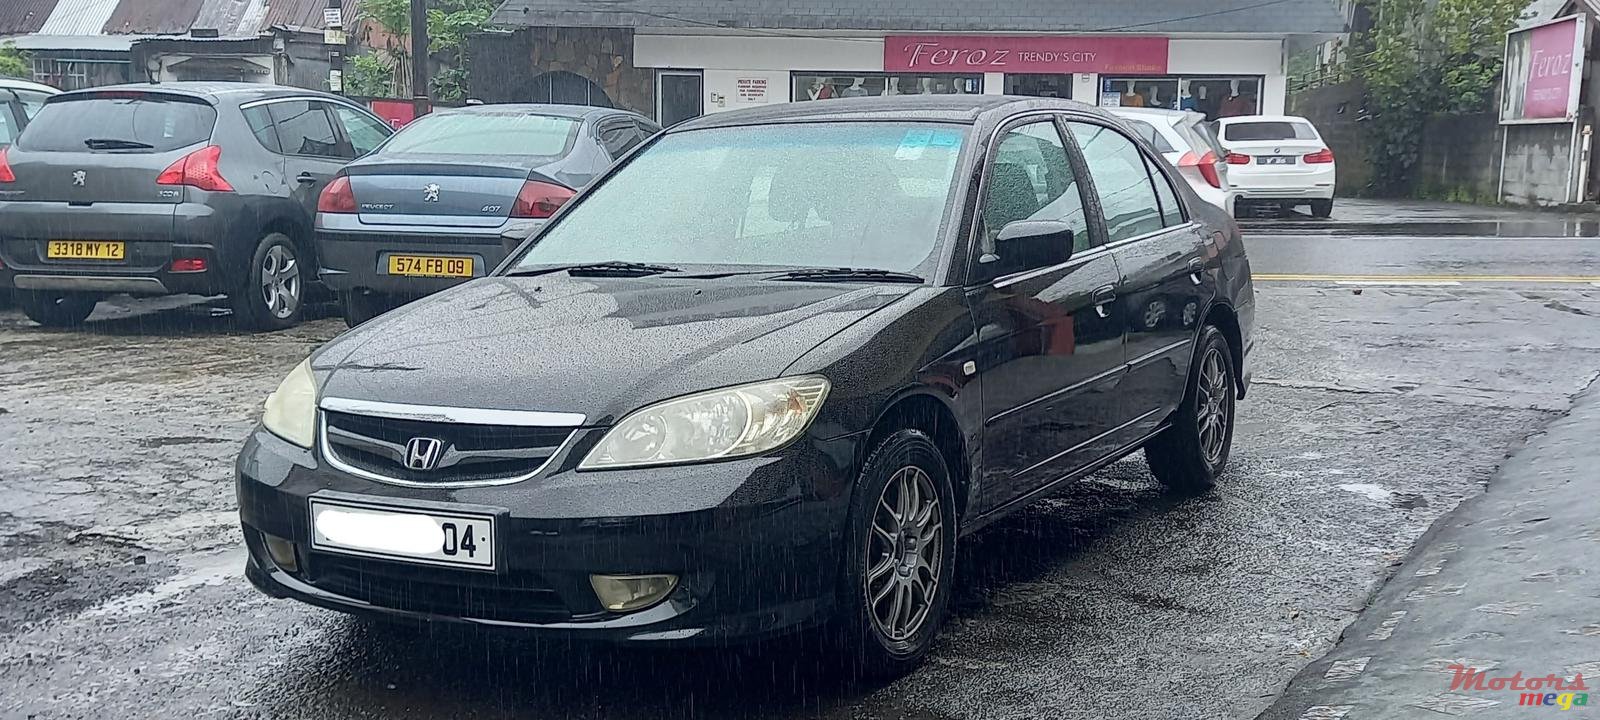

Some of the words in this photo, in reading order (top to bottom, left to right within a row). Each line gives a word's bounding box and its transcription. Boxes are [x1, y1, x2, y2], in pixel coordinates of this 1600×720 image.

[904, 42, 1010, 68] Feroz
[1018, 52, 1069, 62] TRENDY'S
[1072, 52, 1097, 62] CITY
[1529, 49, 1572, 82] Feroz
[54, 243, 82, 256] 3318
[86, 243, 100, 256] MY
[105, 244, 119, 257] 12
[397, 258, 421, 272] 574
[426, 259, 443, 273] FB
[447, 260, 464, 274] 09
[442, 523, 476, 558] 04
